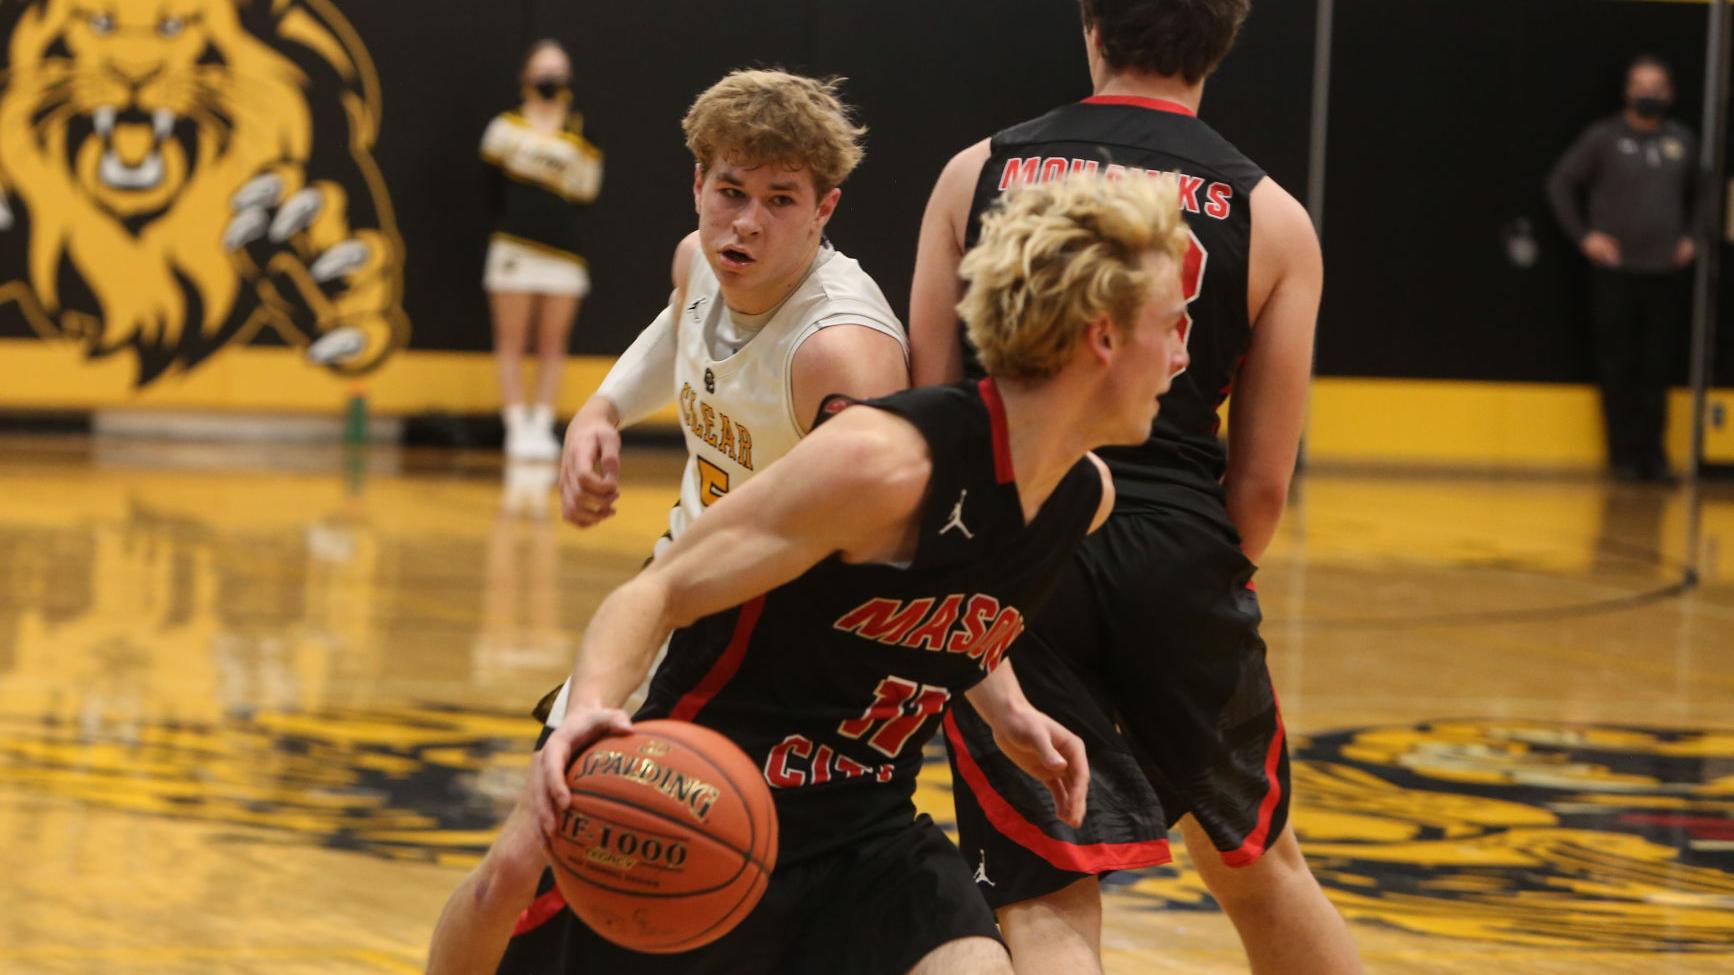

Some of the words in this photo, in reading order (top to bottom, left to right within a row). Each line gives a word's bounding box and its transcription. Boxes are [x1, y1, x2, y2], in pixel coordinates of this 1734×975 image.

[998, 157, 1232, 219] MOKS
[680, 382, 753, 471] CLEAR
[837, 675, 951, 758] 11
[573, 751, 720, 823] SPALDING
